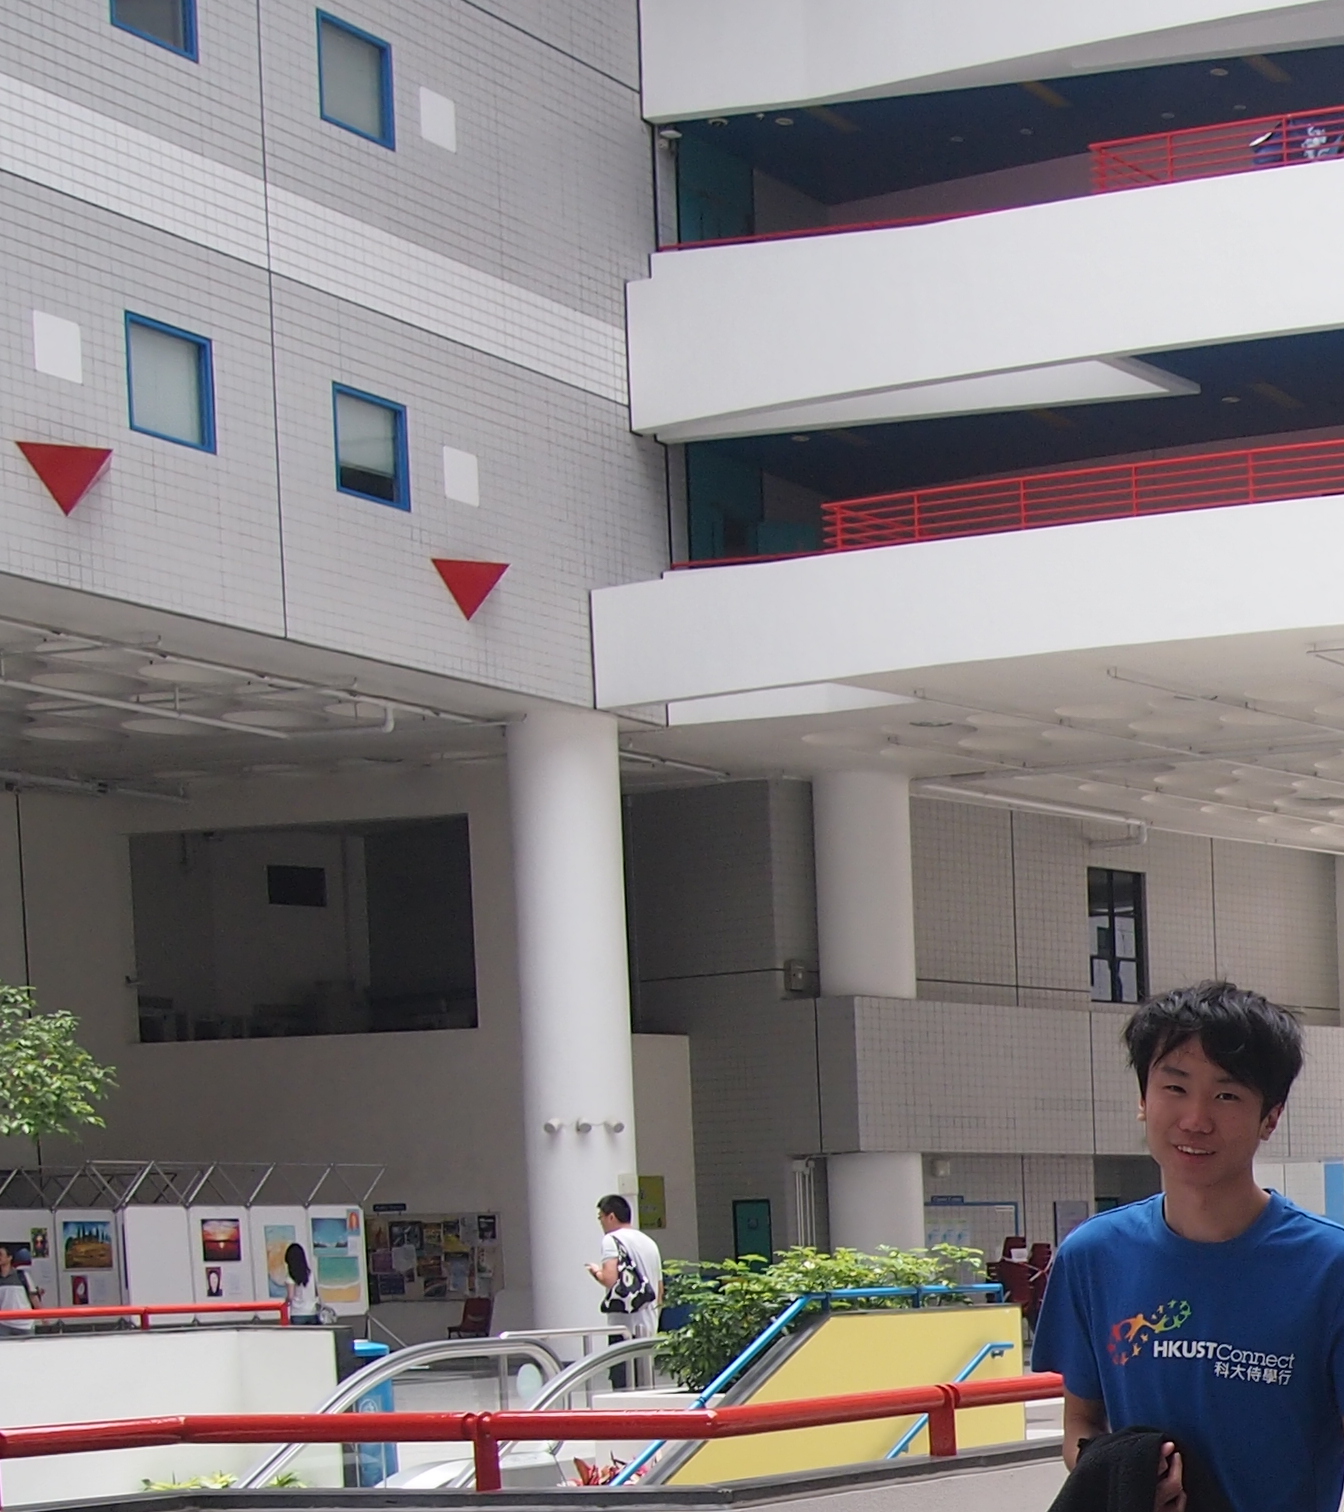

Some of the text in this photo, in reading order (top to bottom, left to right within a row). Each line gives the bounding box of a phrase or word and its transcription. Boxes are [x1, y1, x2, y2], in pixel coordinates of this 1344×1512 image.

[1153, 1340, 1295, 1369] HKUSTConnect
[1213, 1361, 1292, 1386] 科大侍學行
